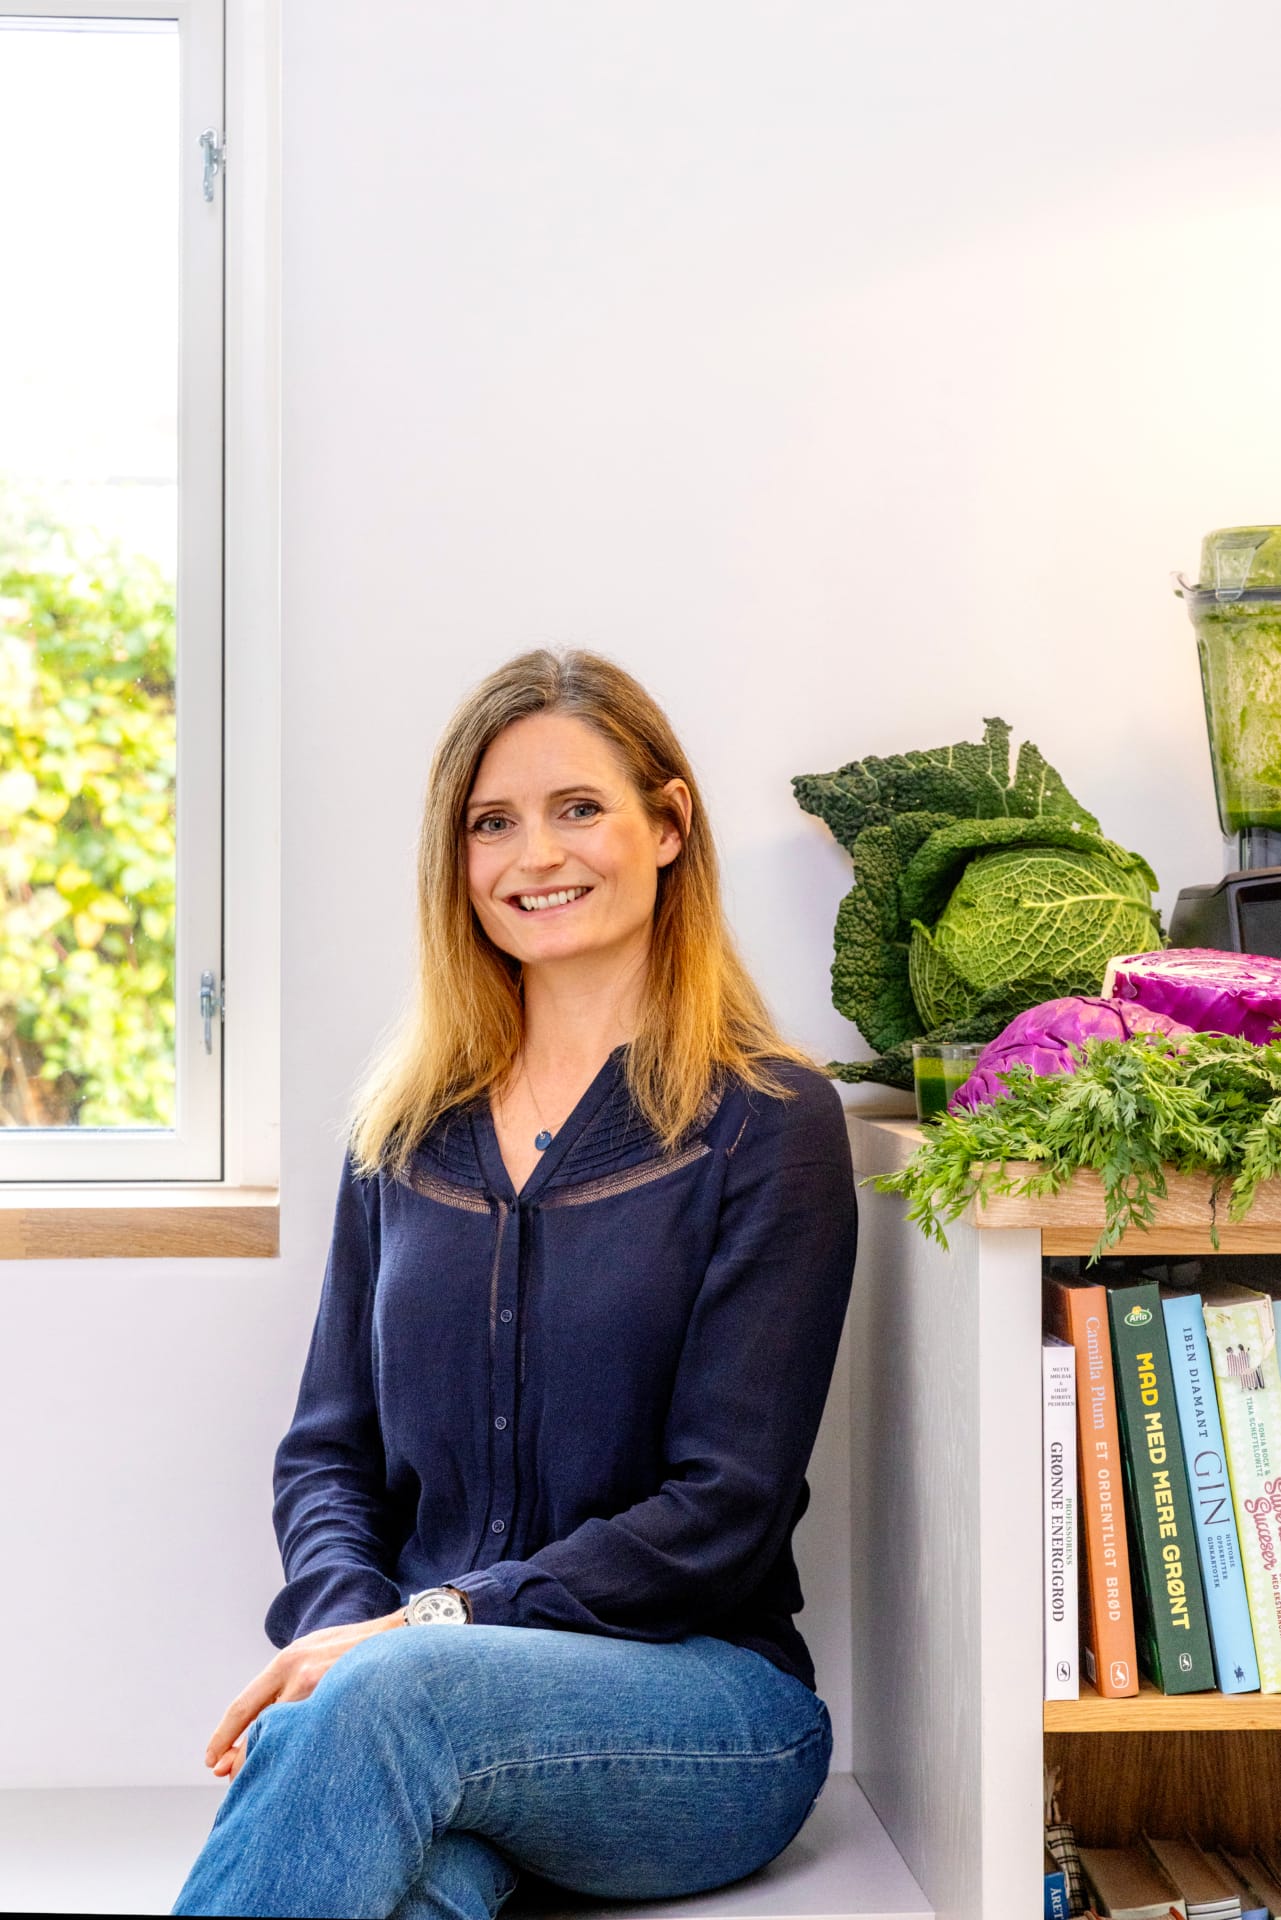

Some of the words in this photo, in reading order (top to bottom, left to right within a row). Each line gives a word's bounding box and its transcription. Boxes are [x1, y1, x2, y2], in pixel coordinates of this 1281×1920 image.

[1086, 1316, 1104, 1380] Camilla
[1129, 1313, 1148, 1323] Arla
[1183, 1327, 1197, 1362] IBEN
[1091, 1385, 1106, 1430] Plum
[1136, 1352, 1159, 1407] MAD
[1189, 1368, 1209, 1438] DIAMANT
[1246, 1396, 1255, 1416] TINA
[1095, 1441, 1109, 1461] ET
[1144, 1411, 1167, 1465] MED
[1257, 1422, 1267, 1447] SONJA
[1050, 1441, 1064, 1510] GRØNNE
[1152, 1470, 1178, 1539] MERE
[1193, 1450, 1231, 1526] GIN
[1065, 1498, 1073, 1566] PROFESSORENS
[1097, 1468, 1118, 1568] ORDENTLIGT
[1244, 1496, 1278, 1572] Succeser
[1051, 1515, 1065, 1622] ENERGIGRØD
[1106, 1576, 1122, 1622] BRØD
[1162, 1544, 1191, 1630] GRØNT
